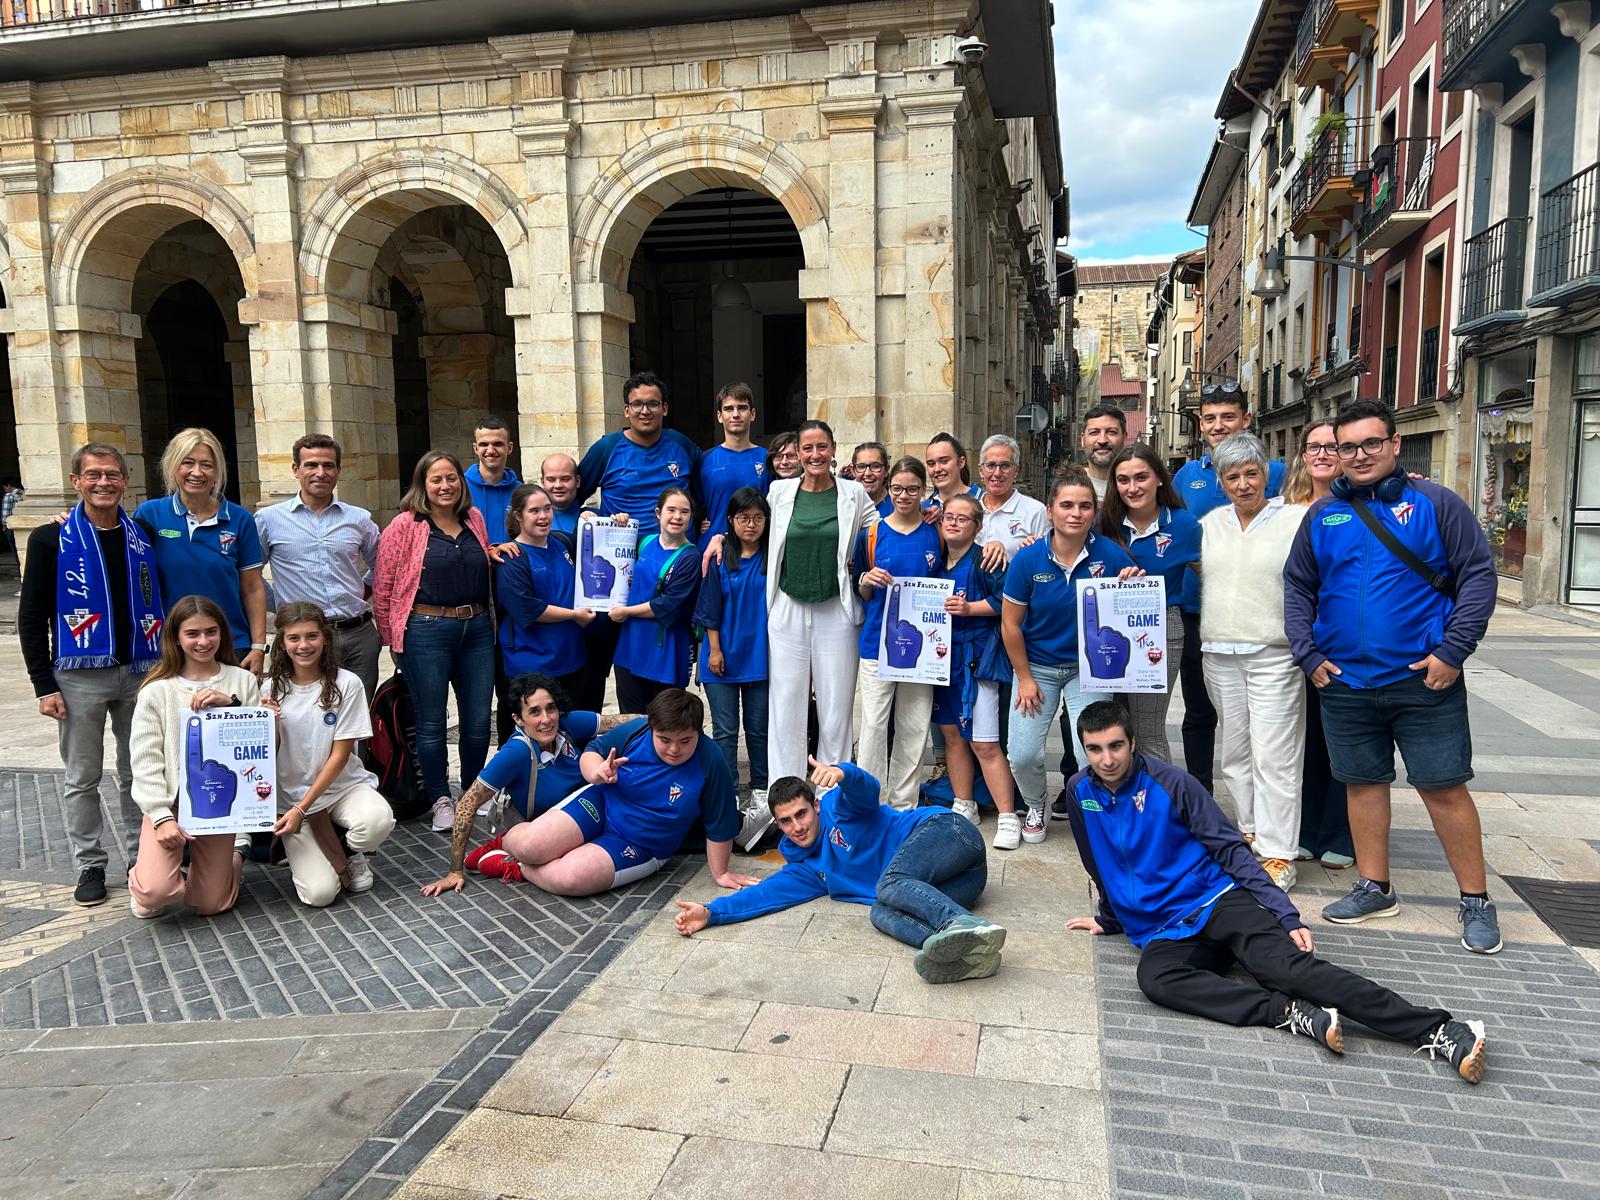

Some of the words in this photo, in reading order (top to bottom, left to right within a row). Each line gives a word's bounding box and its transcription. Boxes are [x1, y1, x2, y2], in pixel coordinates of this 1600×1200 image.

[916, 581, 938, 589] FAUSTO
[1117, 581, 1146, 589] FAUSTO
[922, 611, 947, 625] GAME
[1127, 613, 1160, 628] GAME
[205, 712, 223, 721] SAN
[223, 711, 253, 720] FAUSTO
[254, 710, 269, 718] '25
[223, 726, 264, 740] OPENING
[233, 744, 269, 760] GAME
